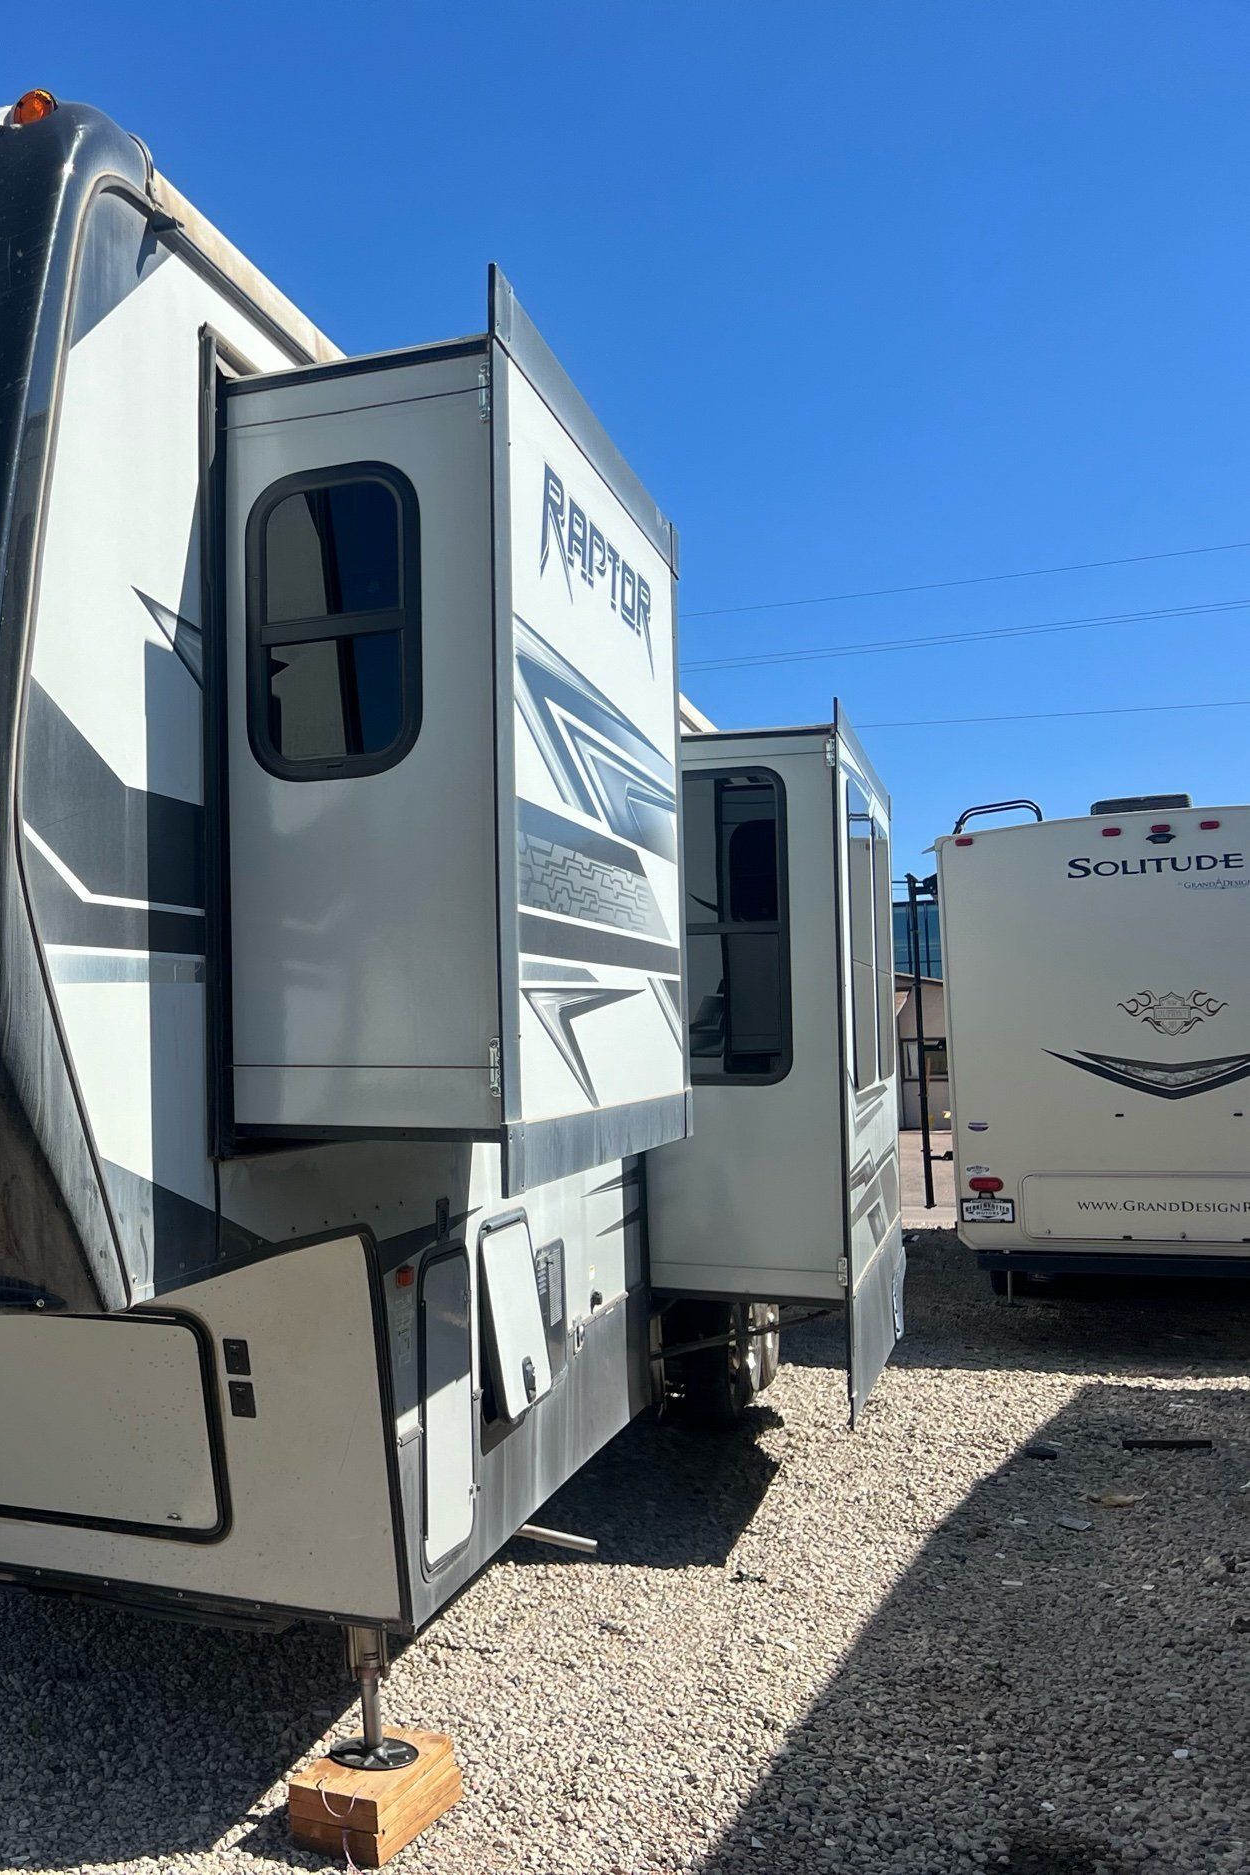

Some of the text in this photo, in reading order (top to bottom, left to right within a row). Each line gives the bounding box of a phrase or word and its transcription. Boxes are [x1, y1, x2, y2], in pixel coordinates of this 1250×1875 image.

[539, 456, 655, 682] RAPTOR
[1067, 852, 1245, 879] SOLITUDE
[1183, 881, 1215, 889] GRAND
